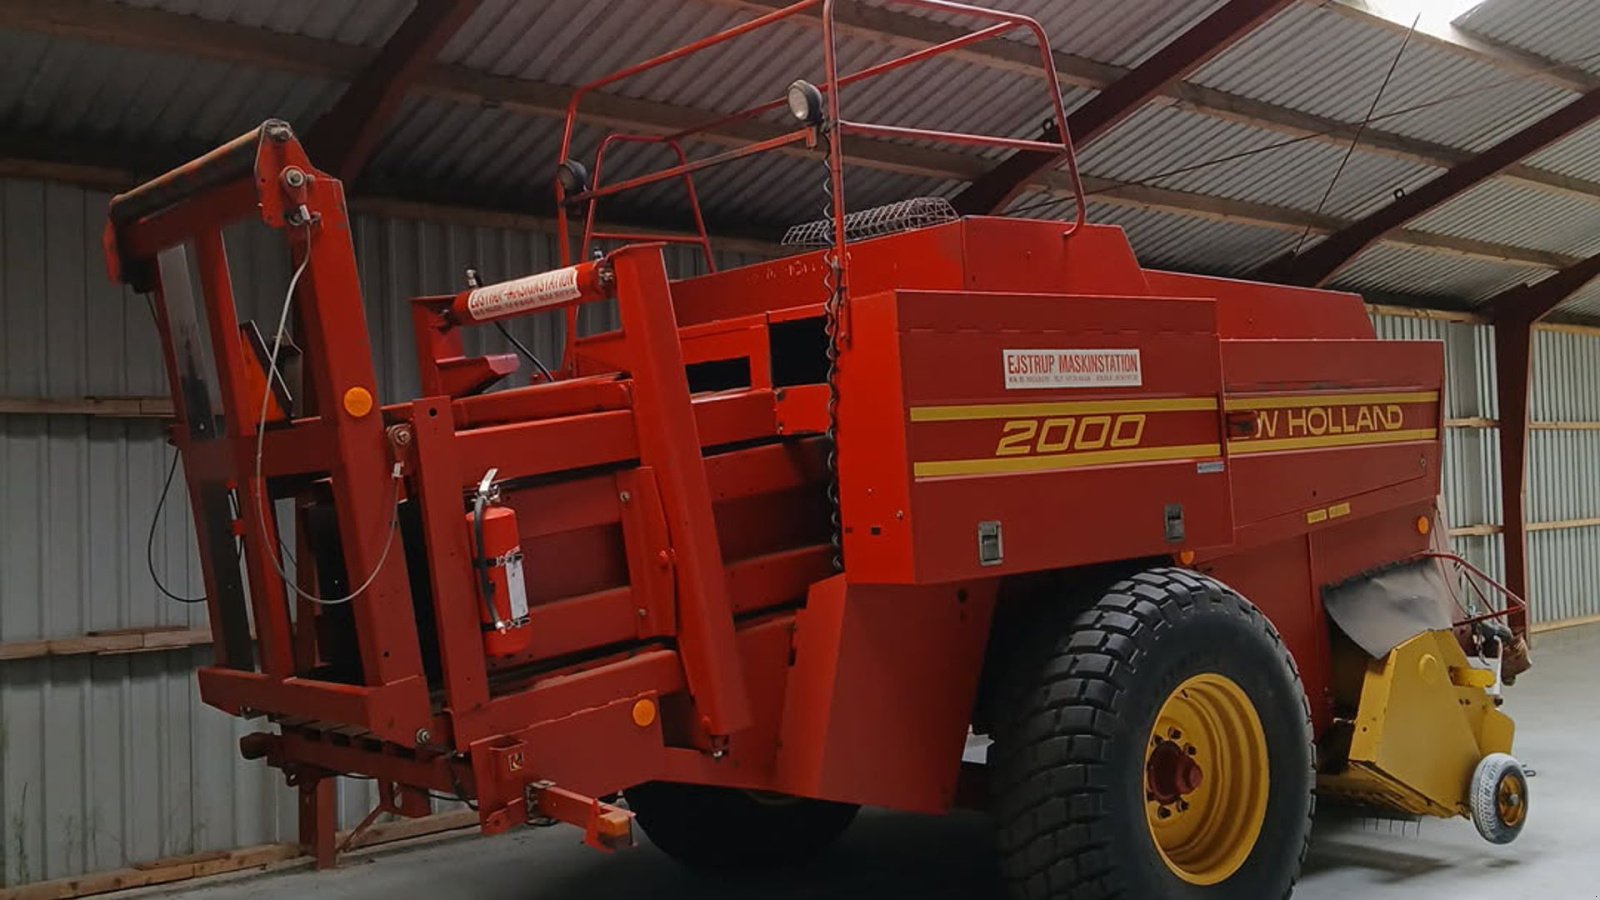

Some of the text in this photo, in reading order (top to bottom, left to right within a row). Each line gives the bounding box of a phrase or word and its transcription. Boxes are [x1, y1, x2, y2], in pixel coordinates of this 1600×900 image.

[1007, 354, 1138, 374] EJSTRUP MASKINSTATION
[995, 414, 1146, 456] 2000
[1287, 404, 1404, 437] HOLLAND
